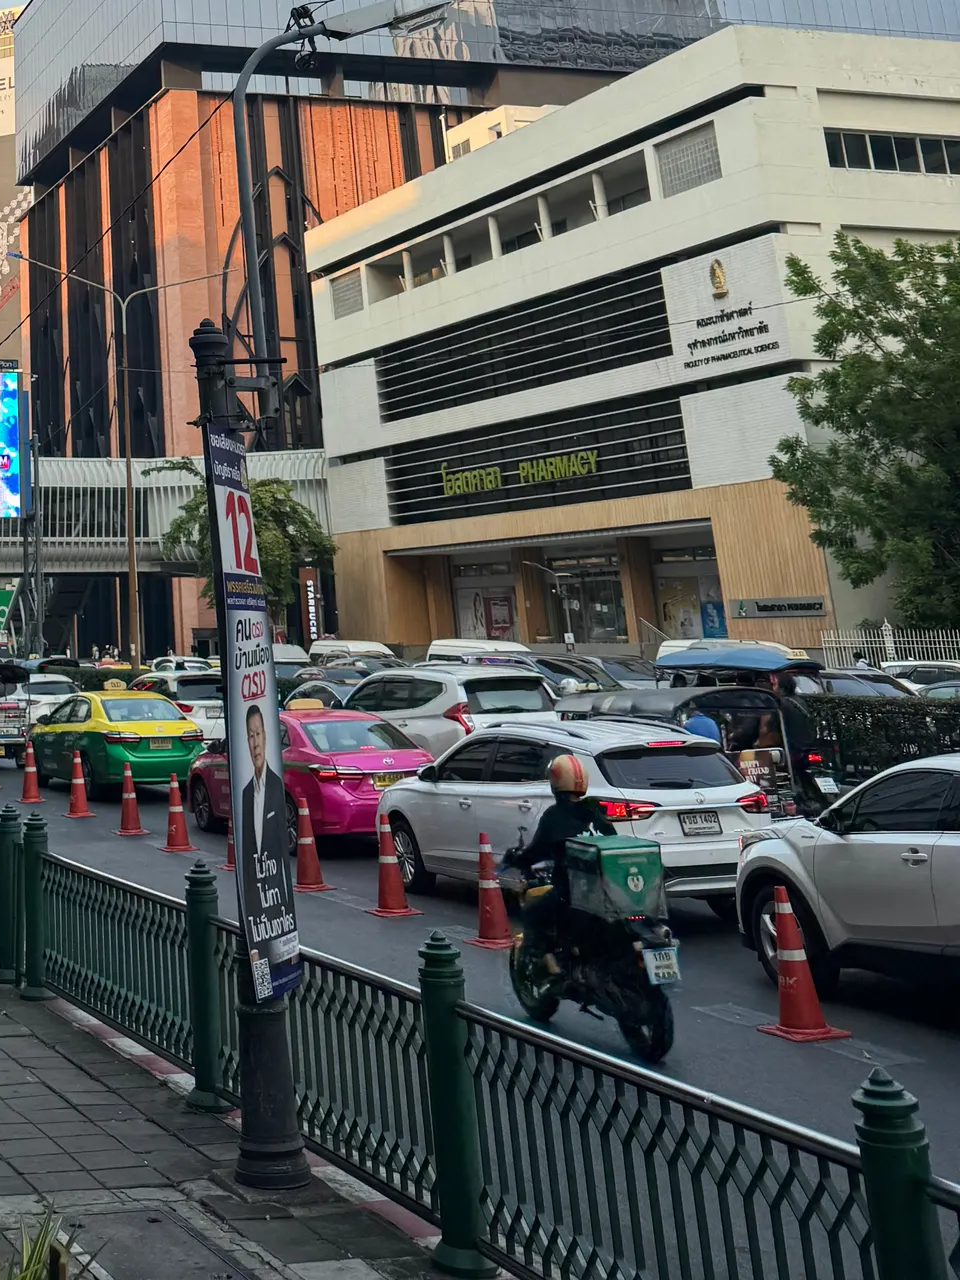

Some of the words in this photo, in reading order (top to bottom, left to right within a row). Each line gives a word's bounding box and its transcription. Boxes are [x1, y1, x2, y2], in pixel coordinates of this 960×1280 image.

[683, 357, 703, 370] FACULTY
[703, 357, 711, 365] OF
[711, 347, 754, 363] PHARMACEUTICAL
[754, 341, 780, 353] SCIENCES
[518, 449, 598, 484] PHARMACY
[225, 490, 259, 576] 12
[306, 580, 318, 640] STARBUCKS
[235, 618, 264, 643] คนตรง
[235, 643, 270, 670] บ้านเมือง
[241, 670, 266, 700] ตรง
[699, 814, 718, 824] 1402
[253, 851, 278, 879] ไม่โกง
[257, 883, 282, 909] ไม่เทา
[248, 906, 295, 943] ไม่เป็นเงาใคร
